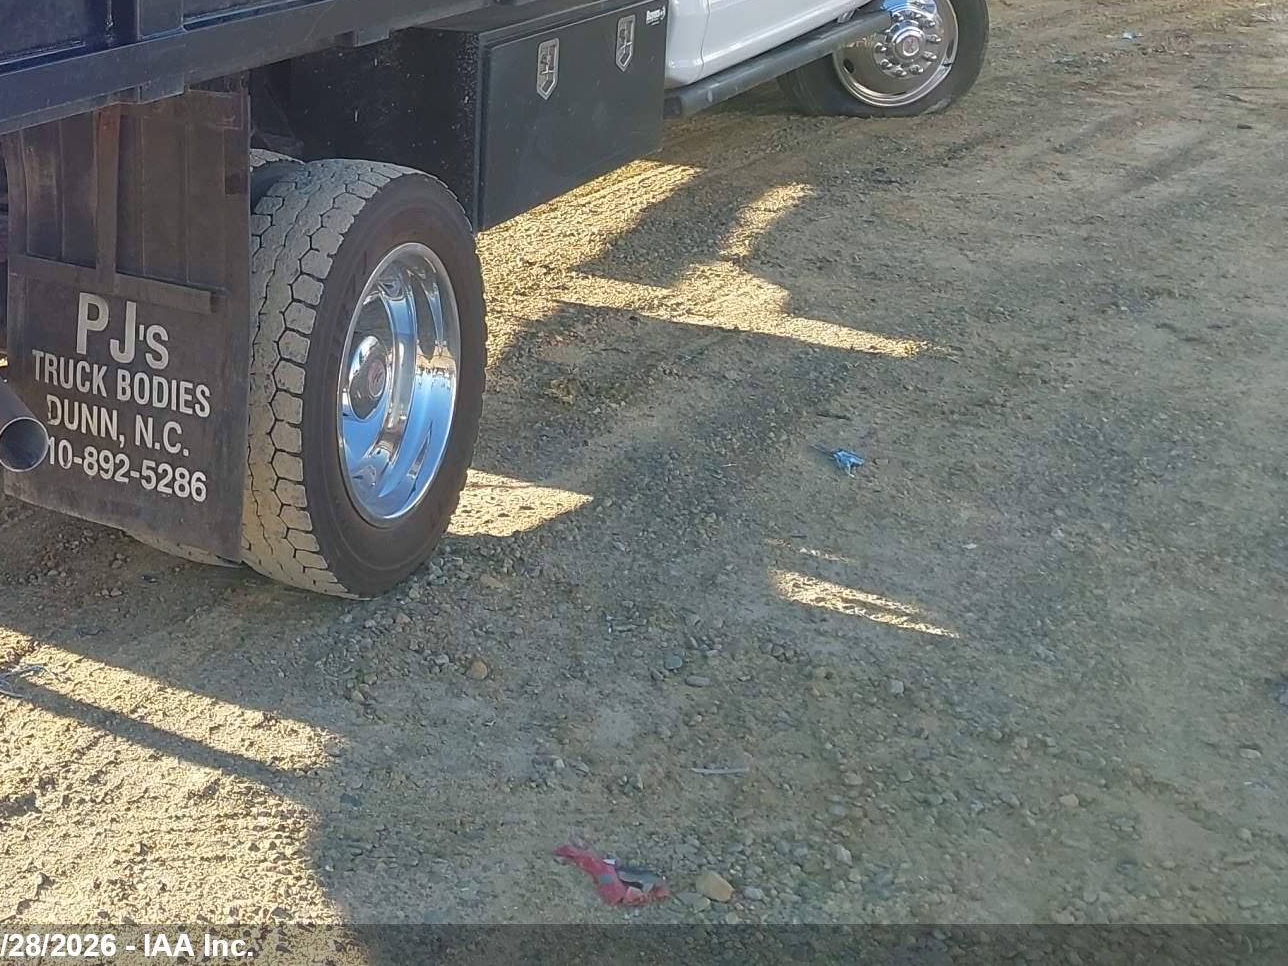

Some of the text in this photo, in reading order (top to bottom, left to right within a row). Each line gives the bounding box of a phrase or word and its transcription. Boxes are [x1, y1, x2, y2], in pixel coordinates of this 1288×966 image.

[32, 349, 210, 418] TRUCK BODIES
[46, 394, 190, 457] DUNN, N.C.
[47, 436, 207, 503] 10-892-5286
